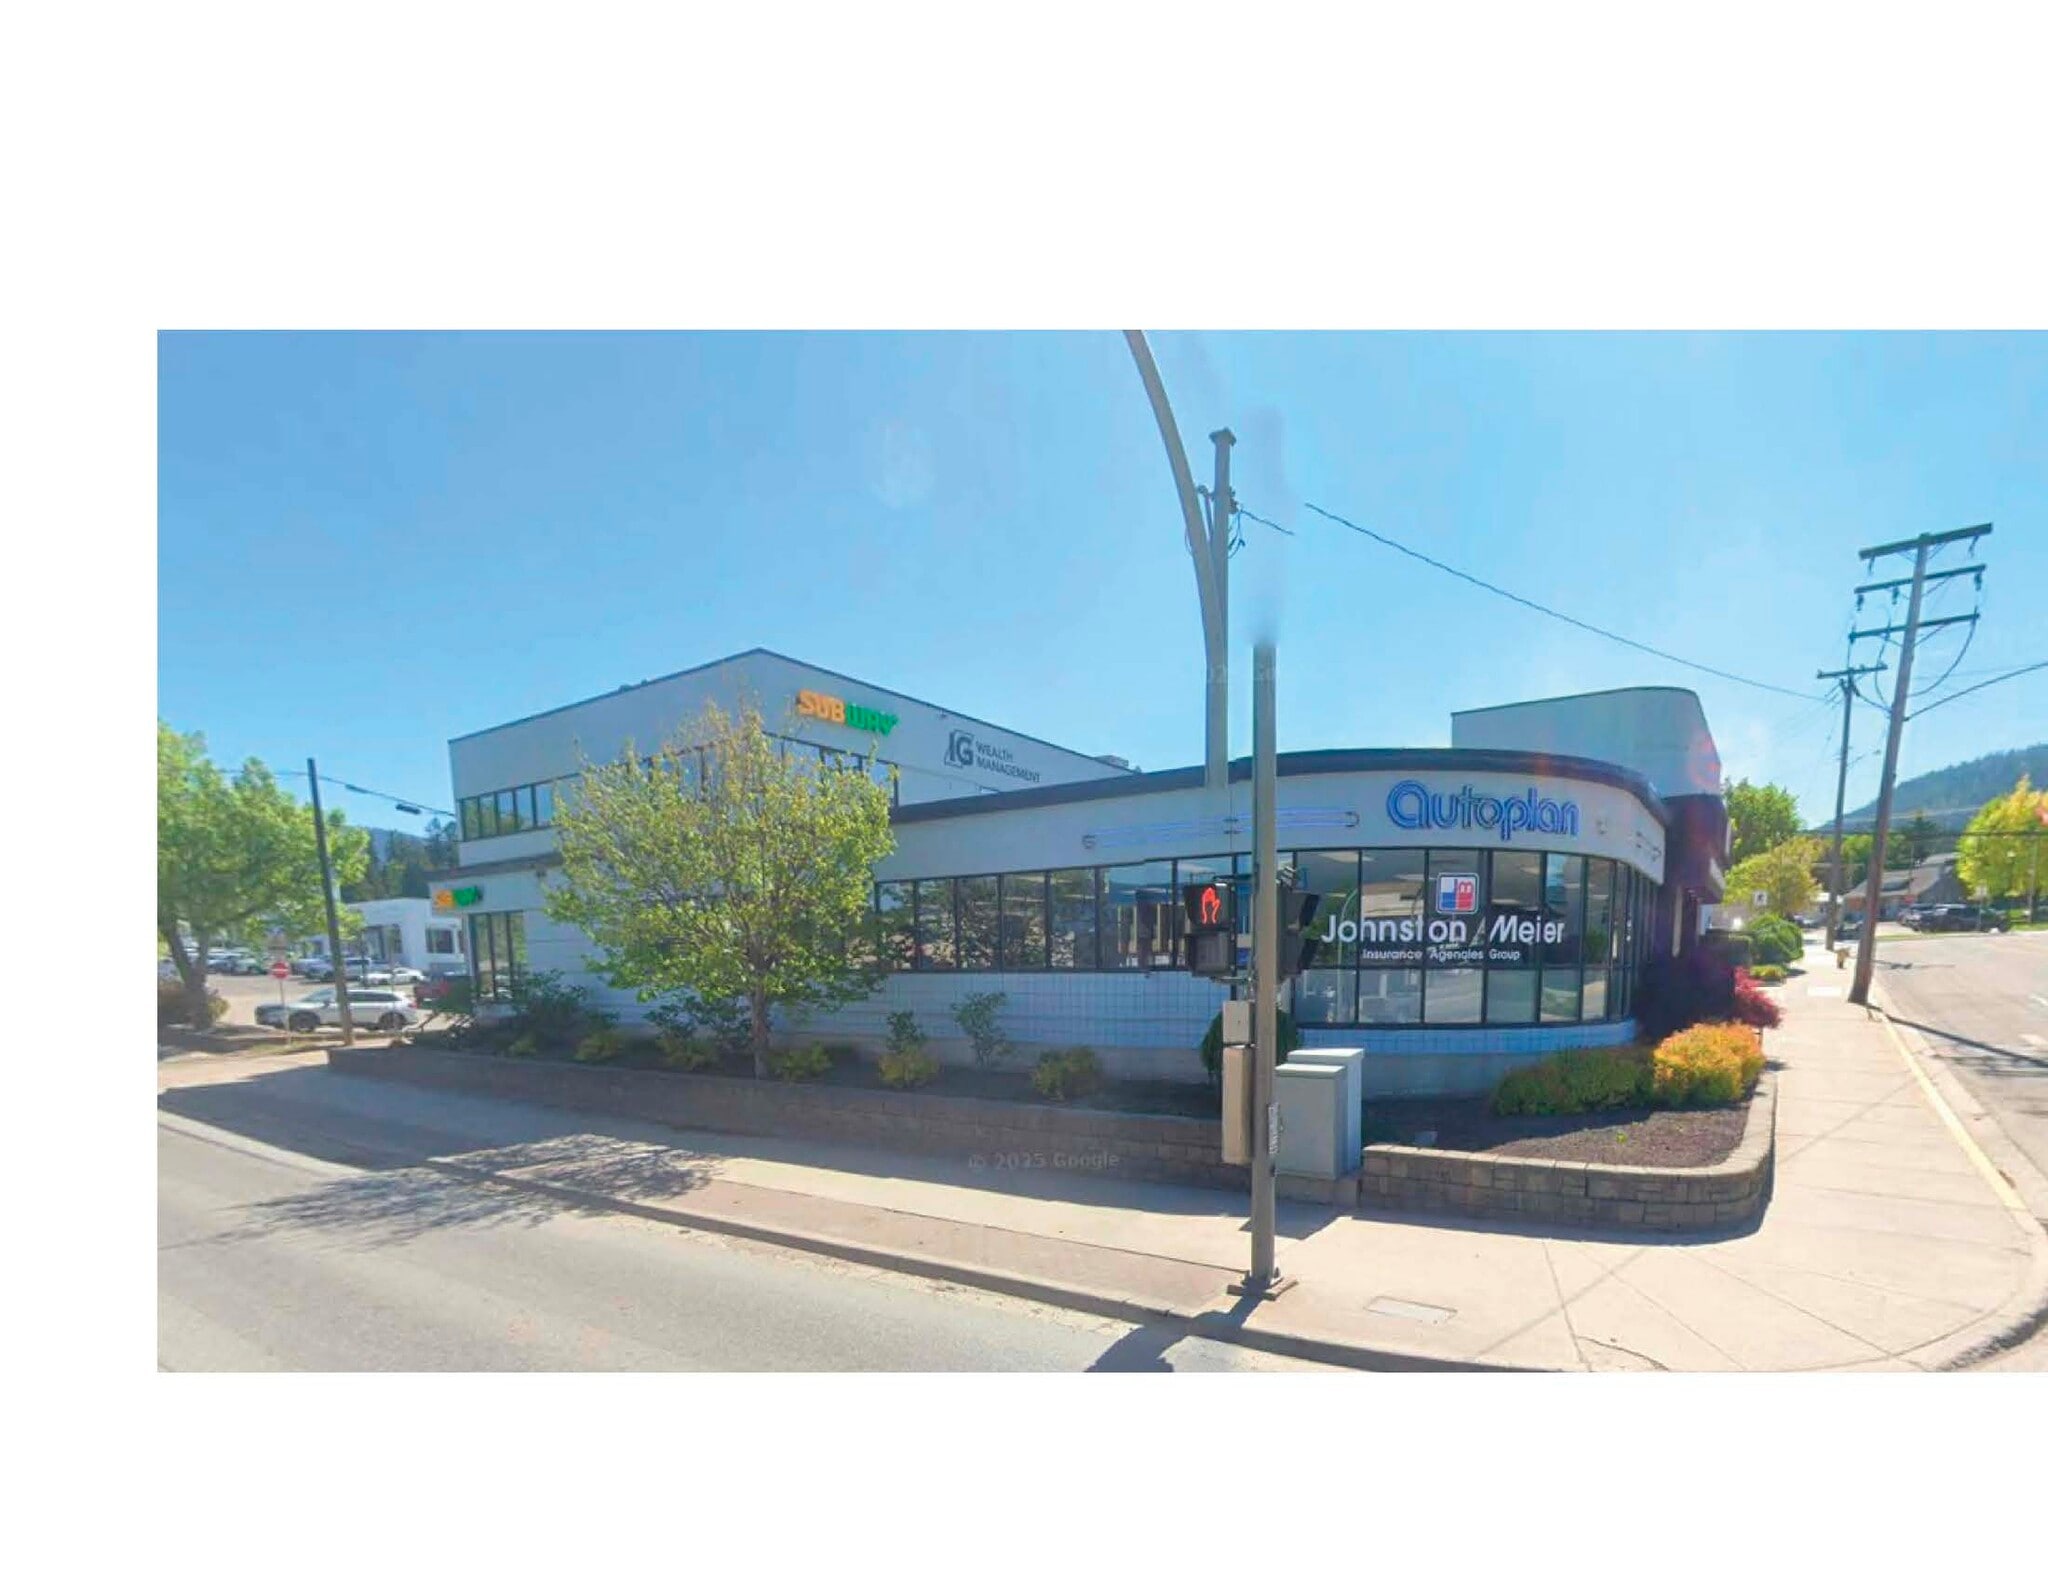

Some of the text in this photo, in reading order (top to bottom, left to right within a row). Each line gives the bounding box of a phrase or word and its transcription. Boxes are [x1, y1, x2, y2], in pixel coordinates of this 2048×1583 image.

[798, 689, 898, 736] SUBWAY
[946, 730, 974, 767] IG
[975, 741, 1013, 761] WEALTH
[976, 759, 1041, 783] MANAGEMENT
[1321, 914, 1565, 944] Johnston Meier
[1362, 948, 1520, 962] Insurance Agencies Group
